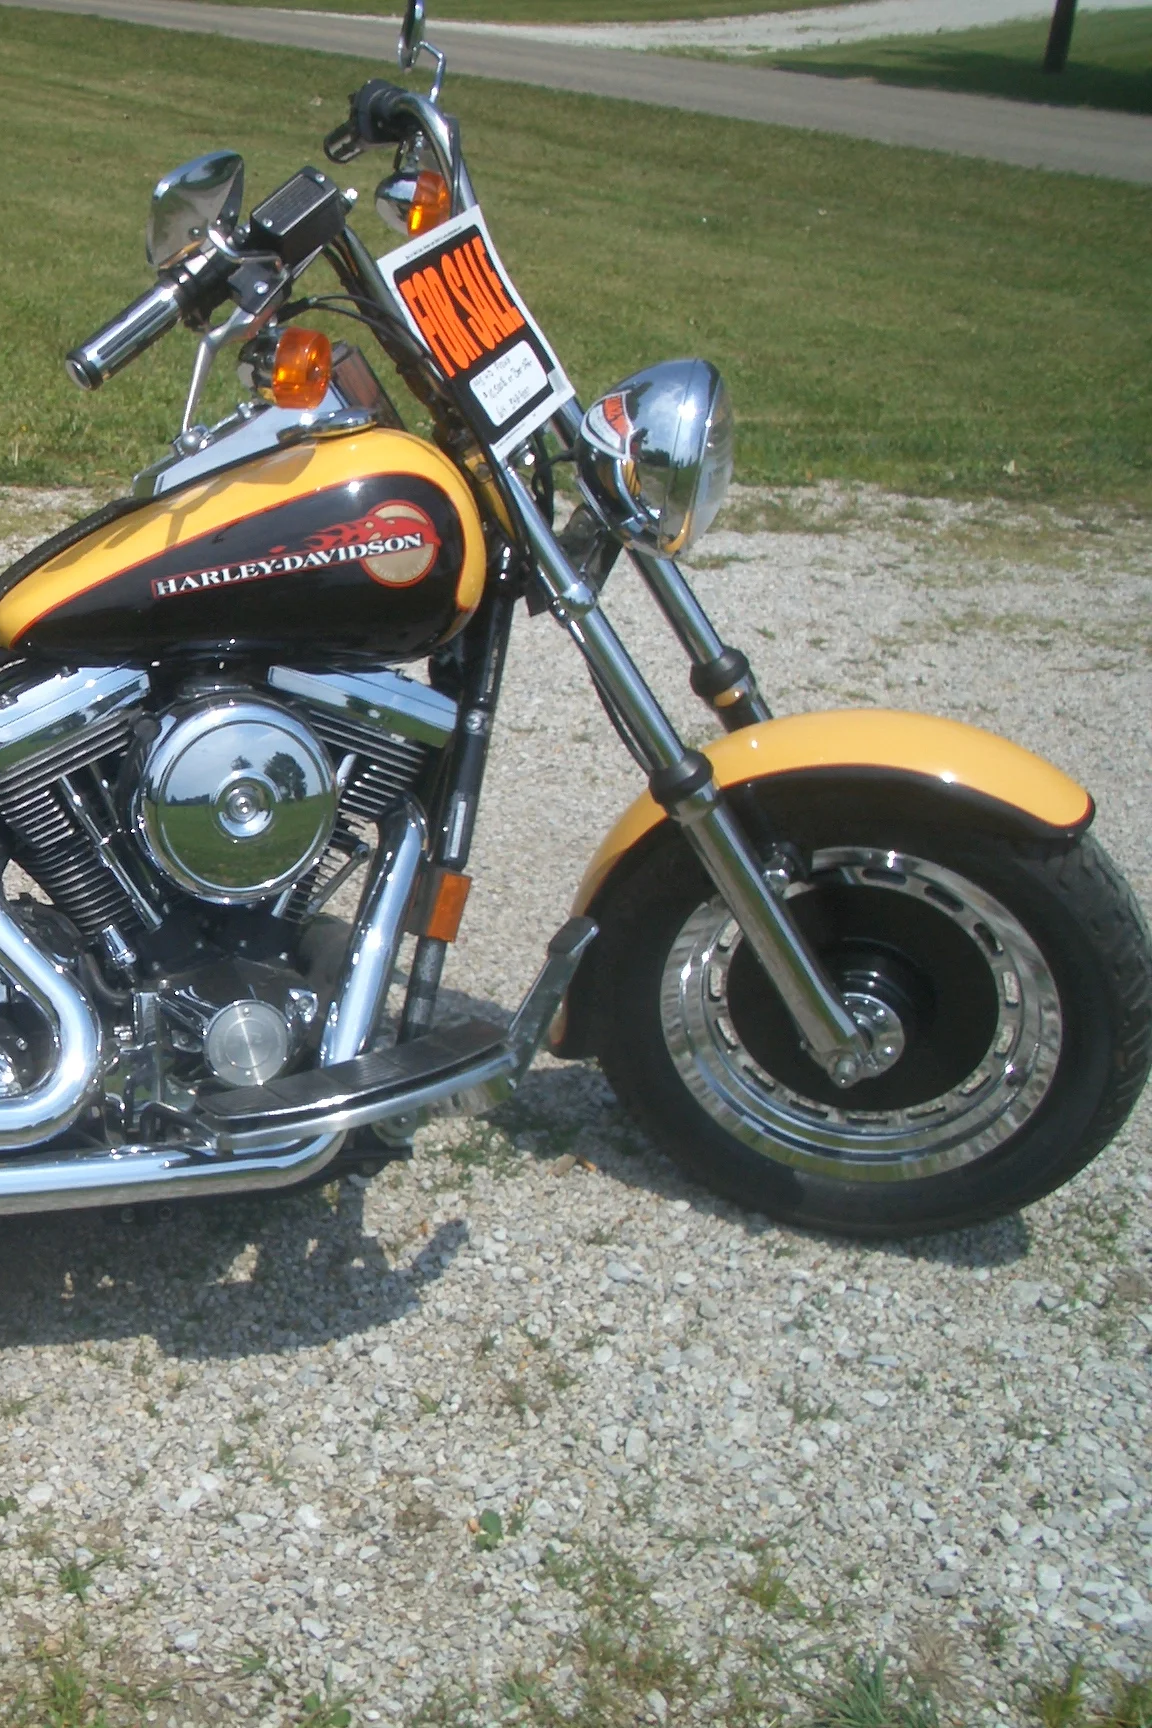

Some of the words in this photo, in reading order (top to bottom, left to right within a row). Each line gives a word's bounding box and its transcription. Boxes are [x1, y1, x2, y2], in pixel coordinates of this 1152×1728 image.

[399, 266, 484, 378] FOR
[441, 235, 526, 350] SALE
[156, 532, 423, 596] HARLEY-DAVIDSON
